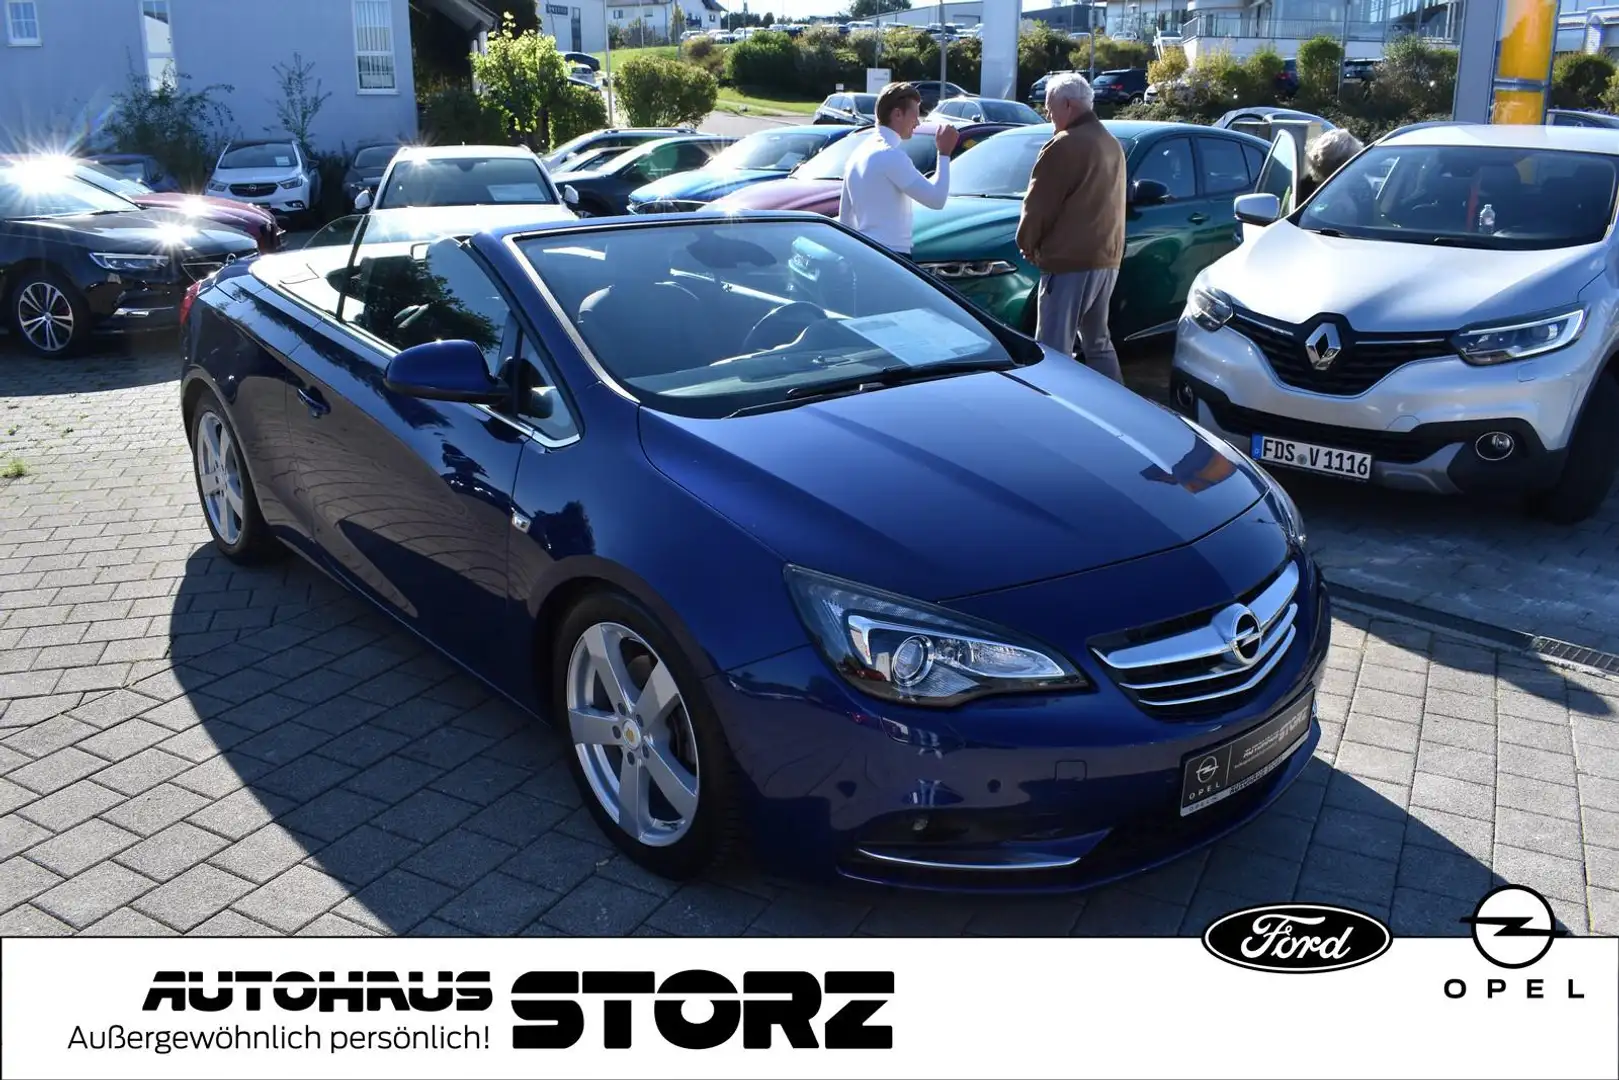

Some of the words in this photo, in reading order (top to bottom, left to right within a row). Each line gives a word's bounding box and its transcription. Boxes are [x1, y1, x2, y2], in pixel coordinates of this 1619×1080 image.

[1263, 439, 1295, 462] FDS
[1309, 447, 1319, 467] V
[1323, 450, 1368, 476] 1116
[1189, 782, 1220, 801] OPEL
